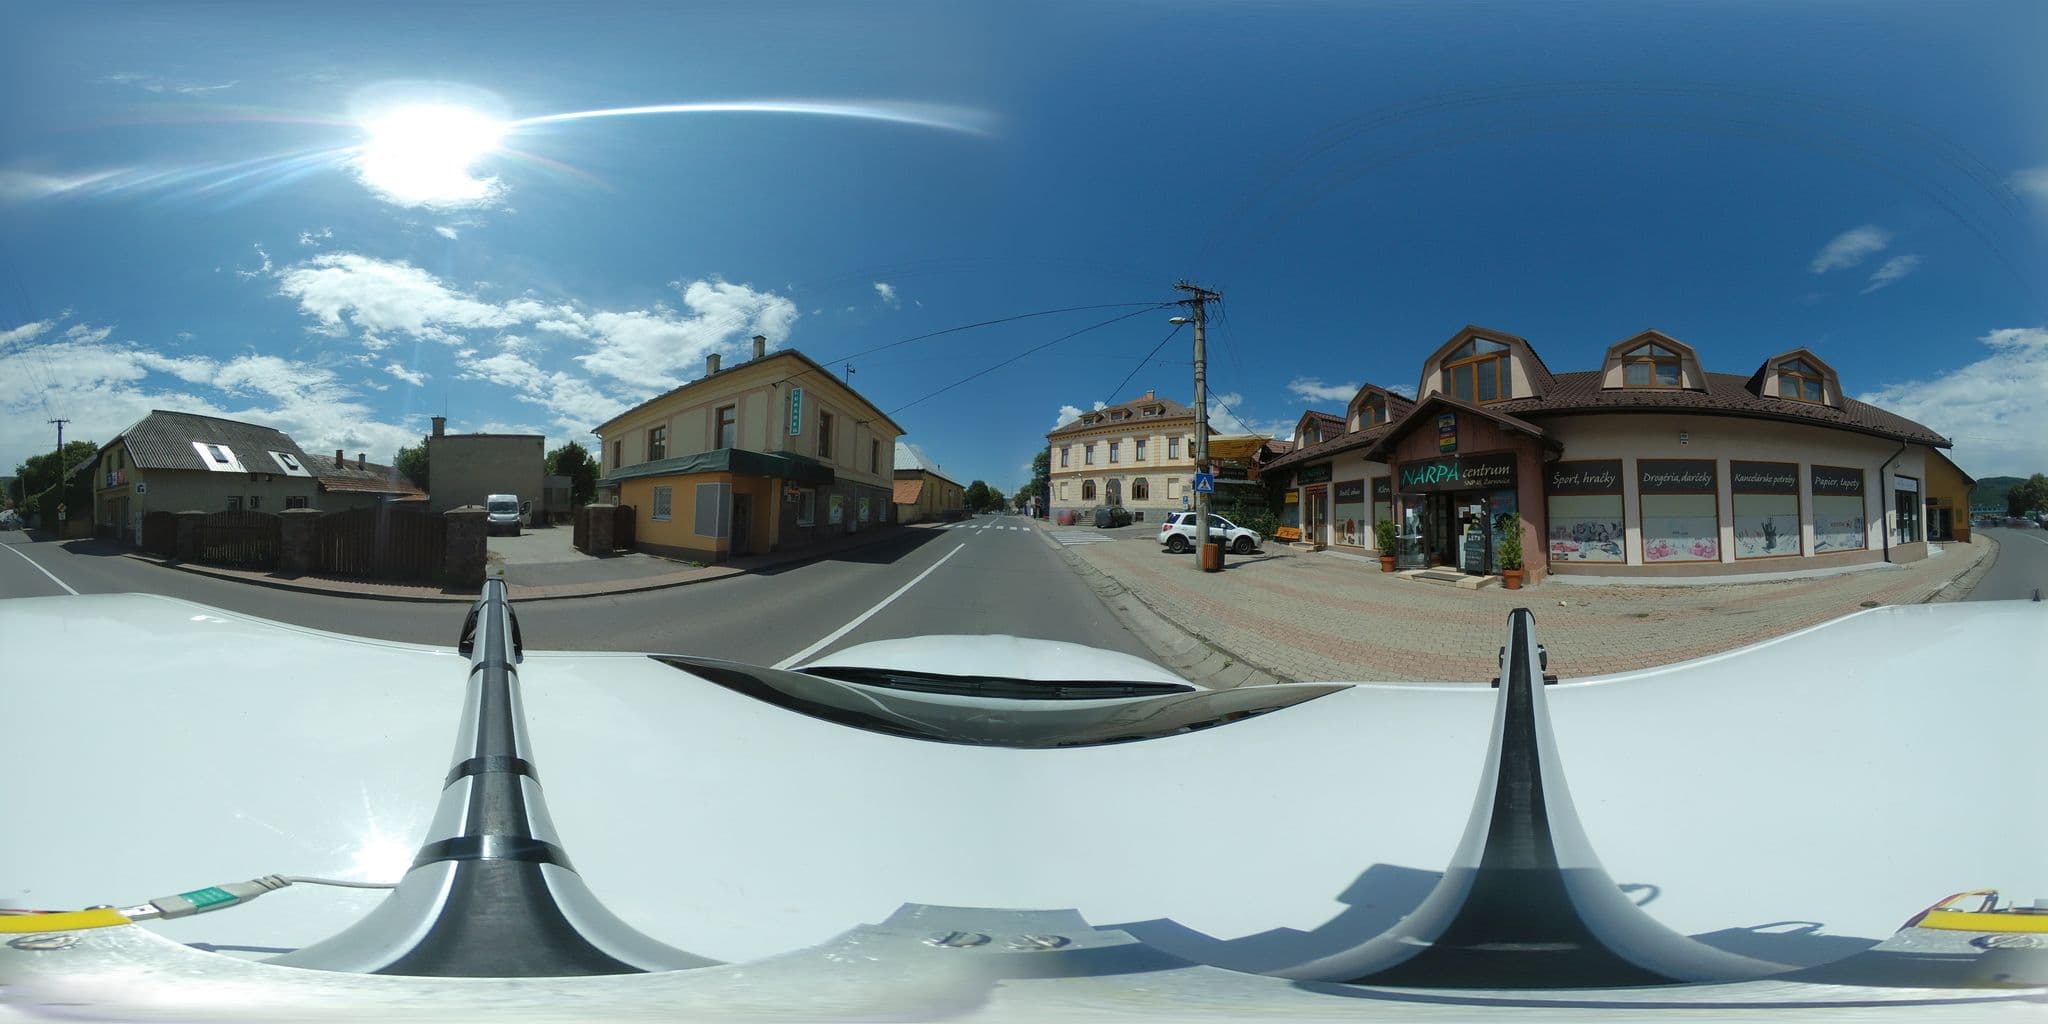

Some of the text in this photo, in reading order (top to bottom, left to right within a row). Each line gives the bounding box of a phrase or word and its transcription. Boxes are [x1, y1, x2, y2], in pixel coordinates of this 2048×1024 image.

[1402, 462, 1510, 486] NARPA centrum
[1552, 470, 1616, 488] Šport, hračky
[1814, 476, 1839, 489] Papier,
